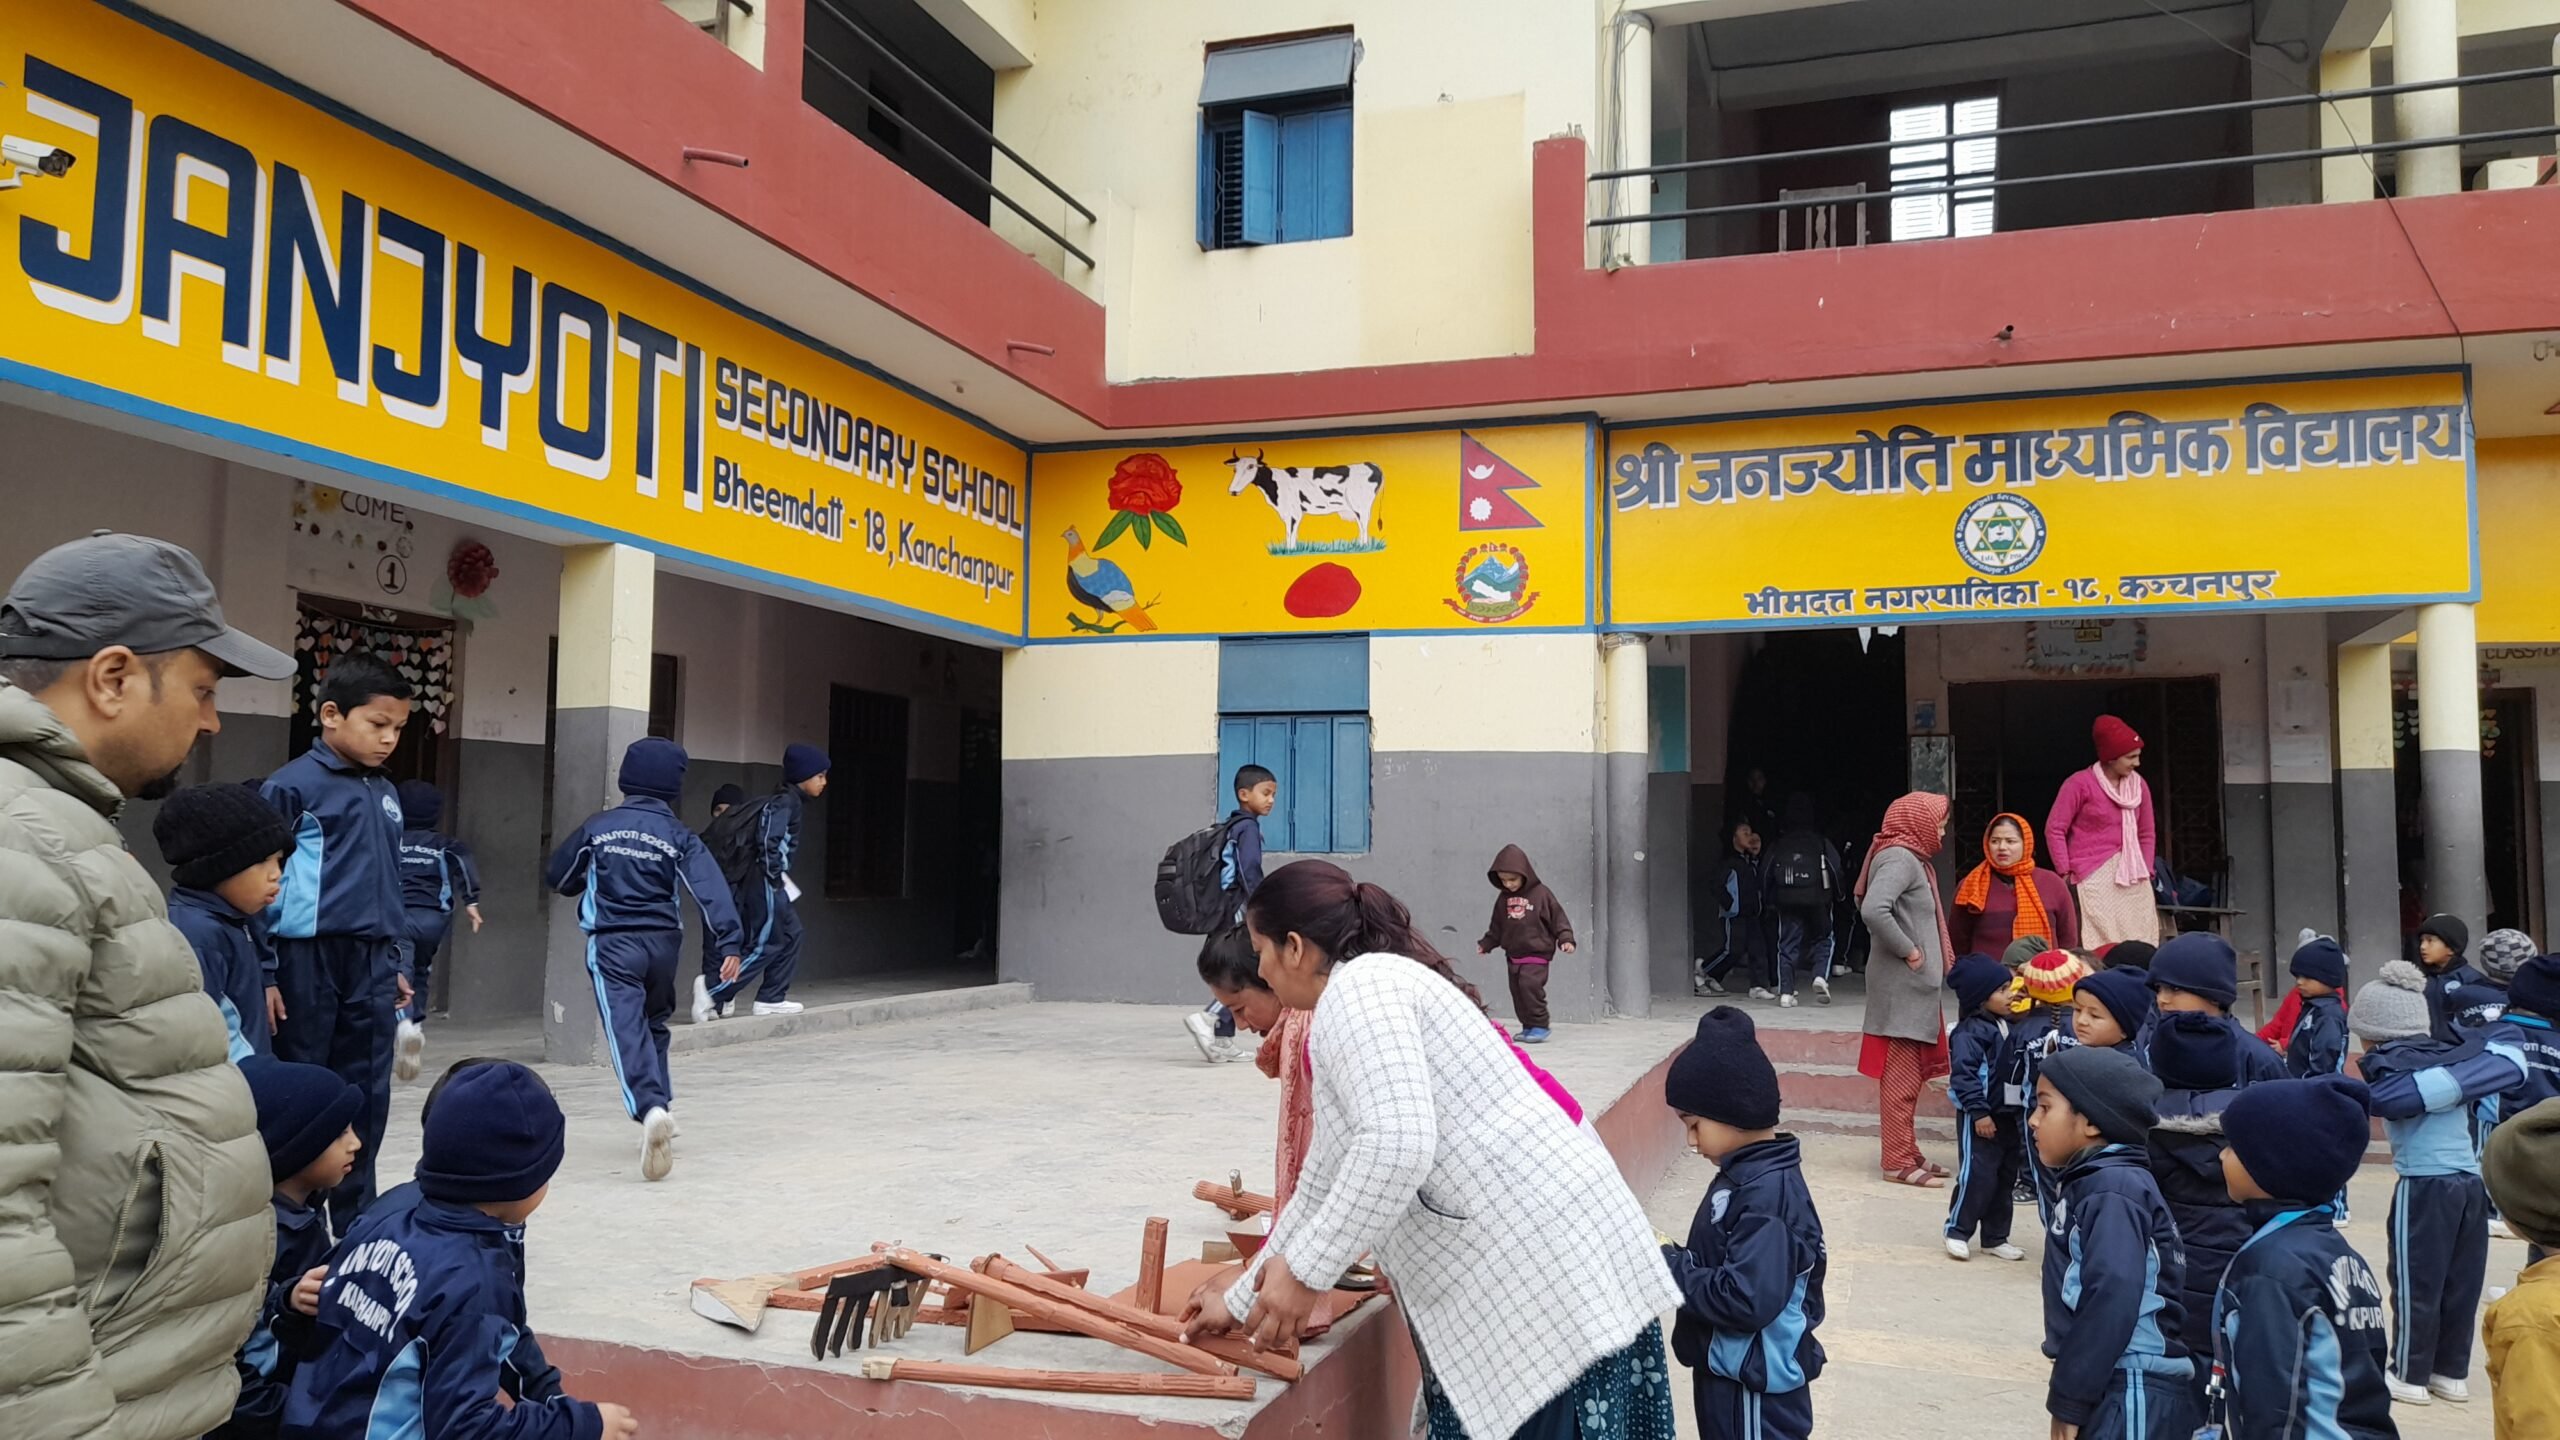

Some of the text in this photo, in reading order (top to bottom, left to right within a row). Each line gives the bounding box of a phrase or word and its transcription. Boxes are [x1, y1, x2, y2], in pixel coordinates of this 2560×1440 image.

[20, 53, 705, 512] JANJYOTI
[715, 356, 1023, 538] SECONDARY SCHOOL
[1612, 402, 2466, 512] श्री जनज्योति माध्यमिक विद्यालय
[713, 455, 844, 541] Bheemdatt
[899, 519, 1015, 603] Kanchanpur
[1864, 576, 2042, 611] नगरपालिका
[592, 830, 677, 857] JANJYOTI SCHOOL
